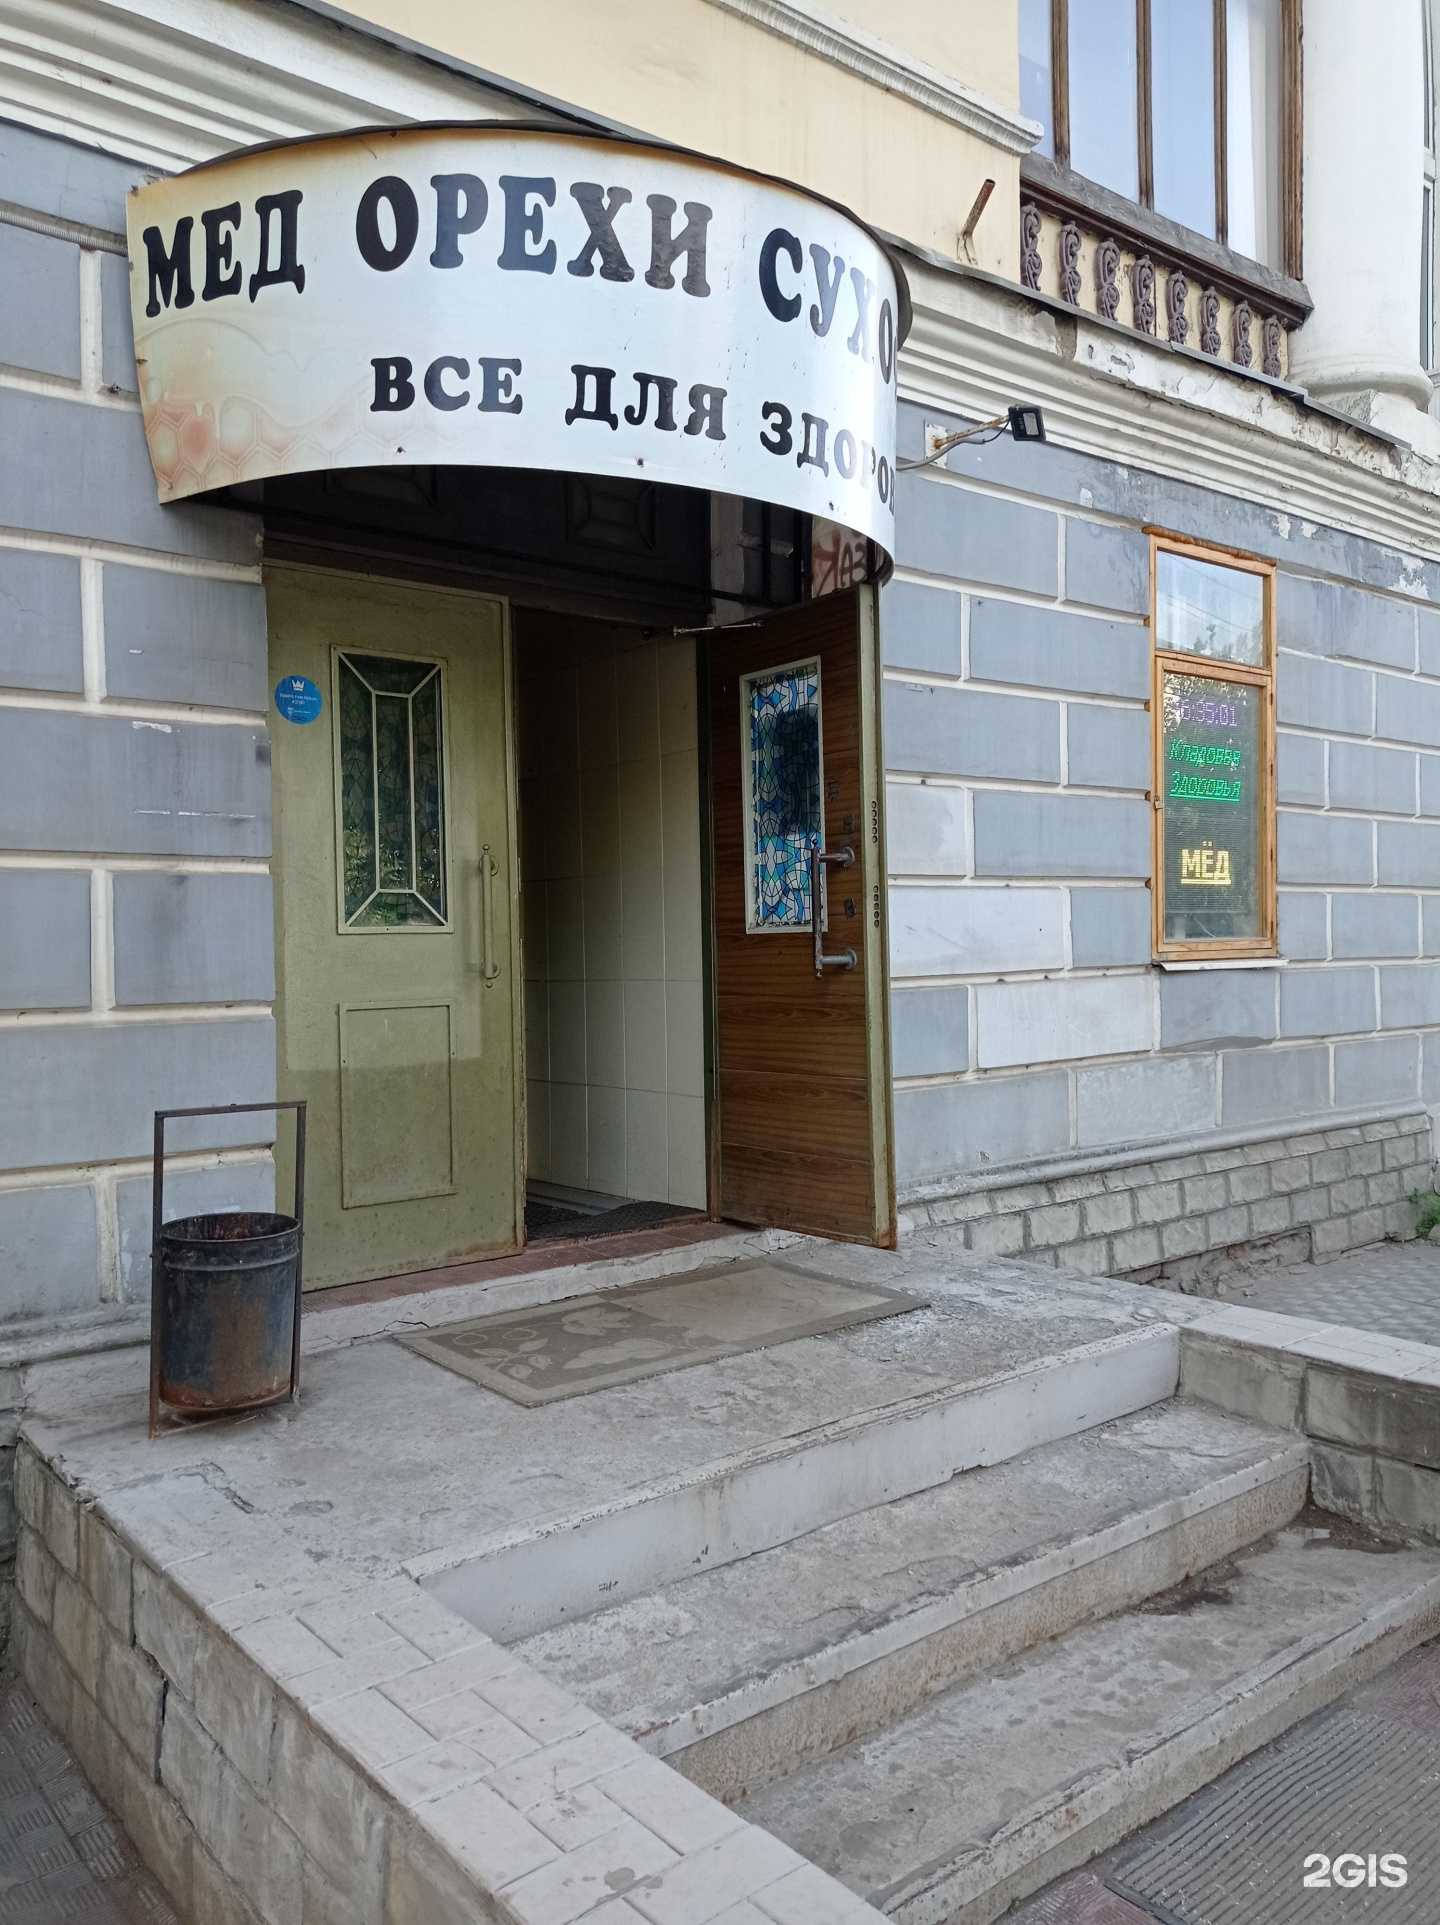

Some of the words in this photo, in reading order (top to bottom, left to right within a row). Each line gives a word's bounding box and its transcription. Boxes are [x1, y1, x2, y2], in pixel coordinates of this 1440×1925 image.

[143, 189, 306, 318] МЕД
[356, 173, 713, 298] ОРЕХИ
[759, 228, 897, 386] СУХО
[370, 356, 523, 415] ВСЕ
[565, 364, 728, 441] ДЛЯ
[1181, 841, 1231, 884] МЁД
